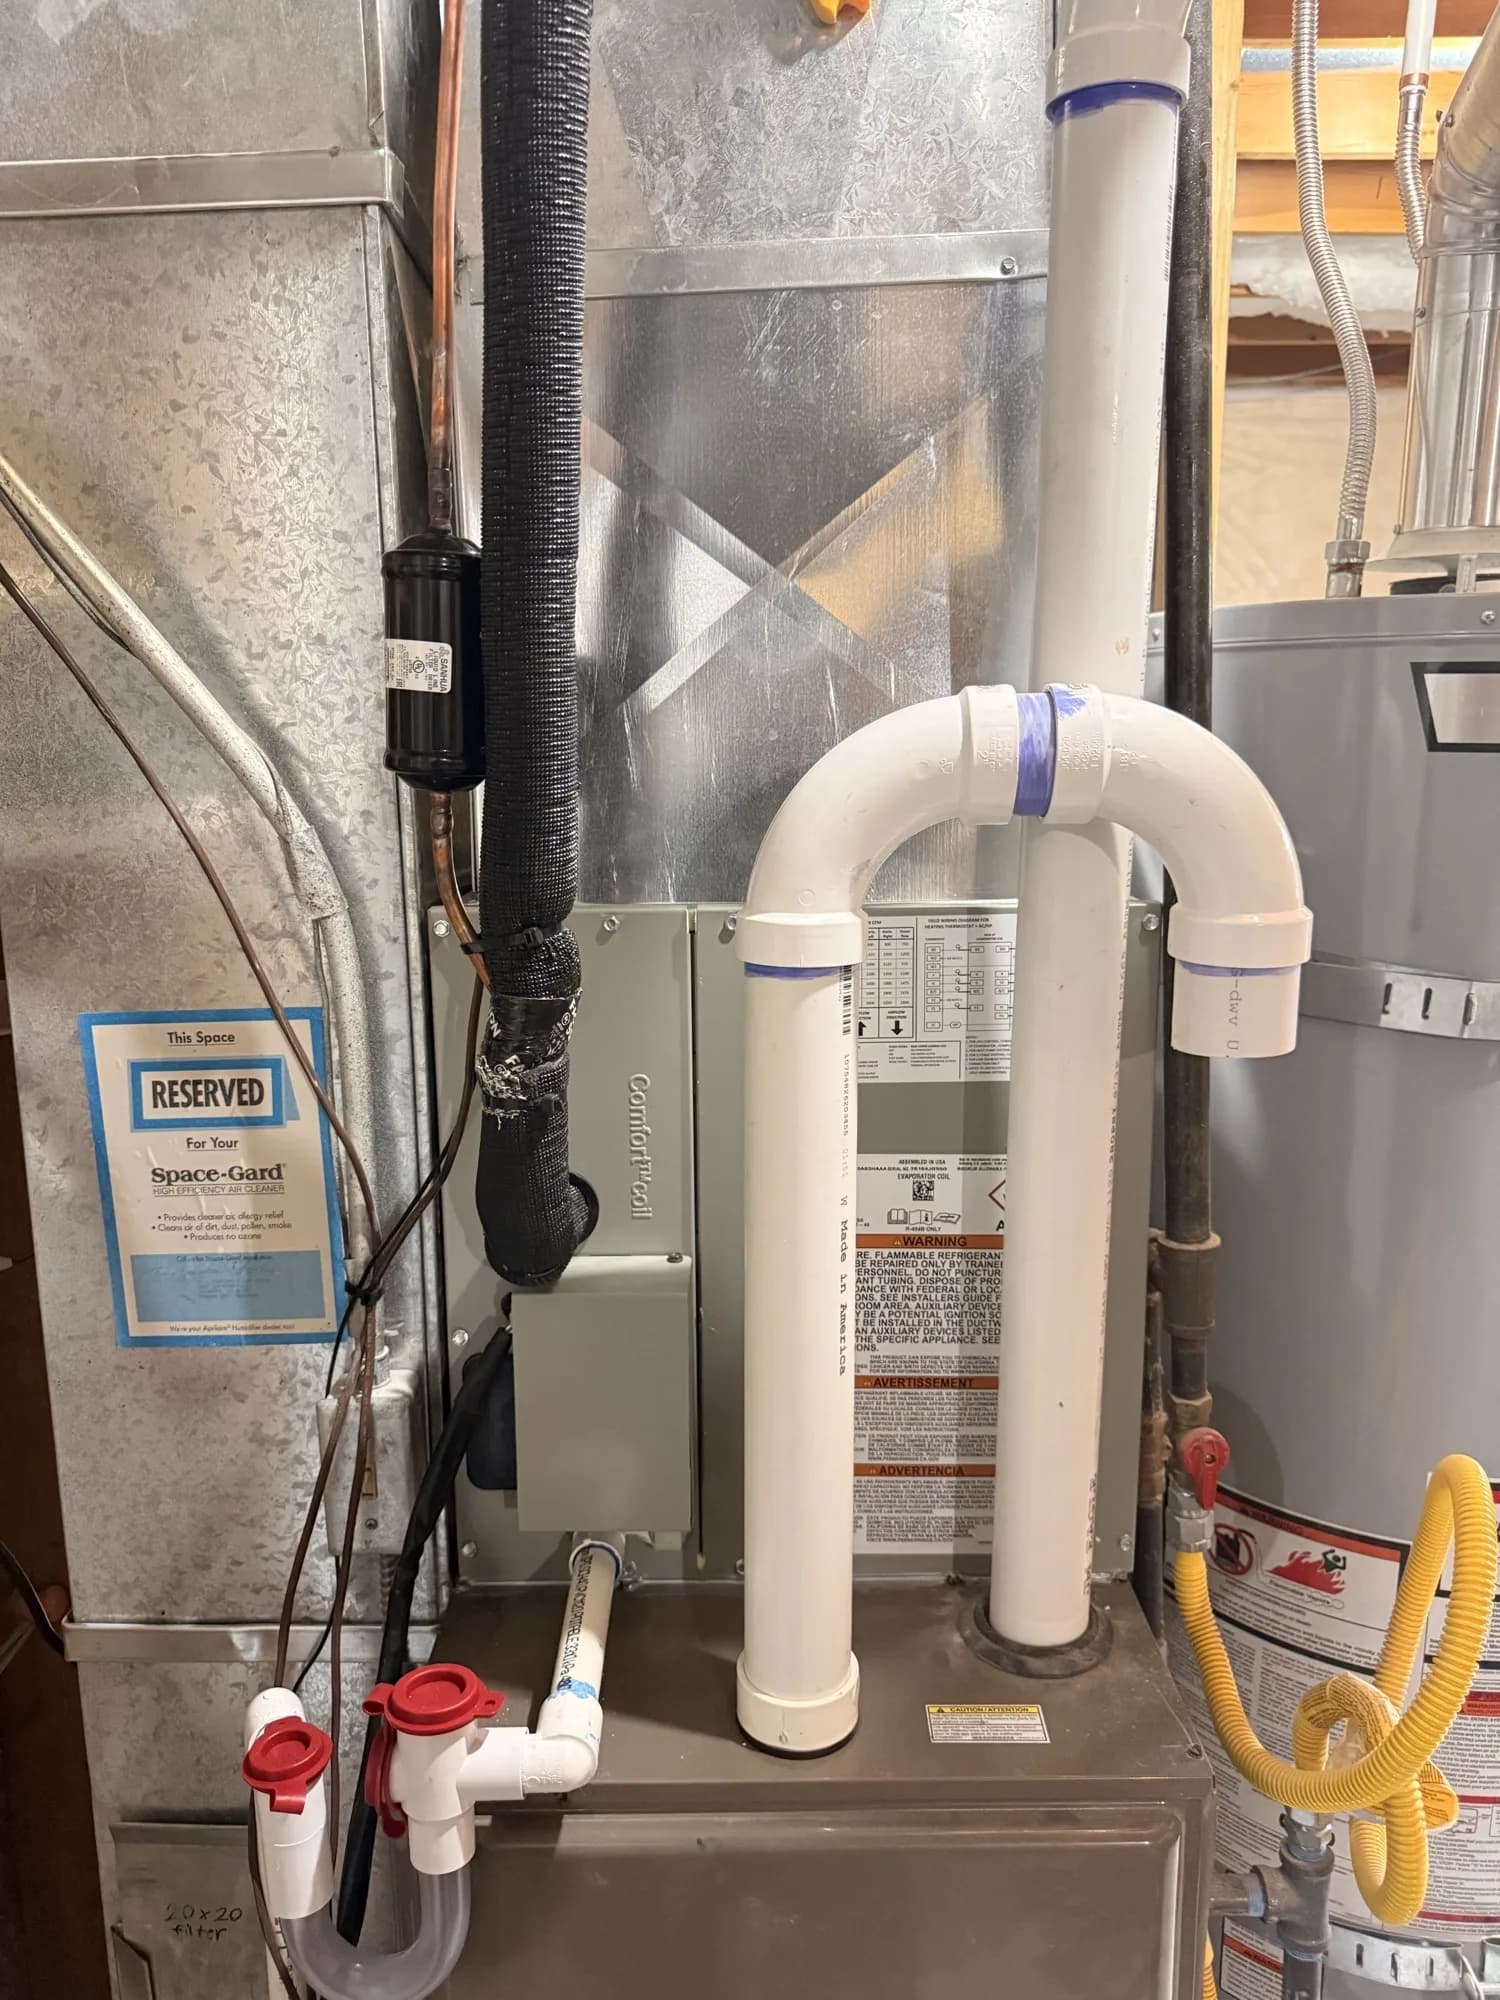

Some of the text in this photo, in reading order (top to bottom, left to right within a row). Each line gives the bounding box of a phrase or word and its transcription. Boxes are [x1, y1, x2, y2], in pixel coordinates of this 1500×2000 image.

[440, 658, 449, 692] SANHUA
[167, 1032, 236, 1045] This Space
[151, 1078, 265, 1109] RESERVED
[186, 1137, 239, 1150] For Your
[153, 1184, 285, 1196] HIGH EFFICIENCY AIR CLEANER
[164, 1213, 196, 1221] Provides
[265, 1210, 284, 1219] relief
[195, 1223, 203, 1231] of
[190, 1232, 224, 1240] Produces
[903, 1237, 968, 1247] WARNING
[875, 1251, 935, 1260] FLAMMABLE
[870, 1260, 918, 1268] REPAIRED
[920, 1260, 946, 1268] ONLY
[949, 1260, 962, 1268] BY
[856, 1277, 874, 1285] ANT
[878, 1277, 916, 1285] TUBING.
[920, 1277, 961, 1285] DISPOSE
[964, 1277, 976, 1285] OF
[839, 1218, 848, 1376] Made in America
[880, 1294, 898, 1302] SEE
[902, 1294, 960, 1302] INSTALLERS
[963, 1294, 992, 1302] GUIDE
[915, 1302, 965, 1310] AUXILIARY
[864, 1310, 876, 1318] BE
[879, 1310, 886, 1318] A
[888, 1310, 941, 1318] POTENTIAL
[944, 1310, 986, 1318] IGNITION
[863, 1319, 876, 1327] BE
[879, 1319, 930, 1327] INSTALLED
[933, 1319, 942, 1327] IN
[946, 1319, 964, 1327] THE
[871, 1327, 920, 1335] AUXILIARY
[923, 1327, 964, 1335] DEVICES
[967, 1327, 1001, 1335] LISTED
[856, 1336, 873, 1344] THE
[876, 1336, 919, 1344] SPECIFIC
[982, 1336, 1001, 1344] SEE
[874, 1377, 975, 1388] AVERTISSEMENT
[879, 1466, 965, 1475] ADVERTENCIA
[172, 1924, 228, 1942] filter
